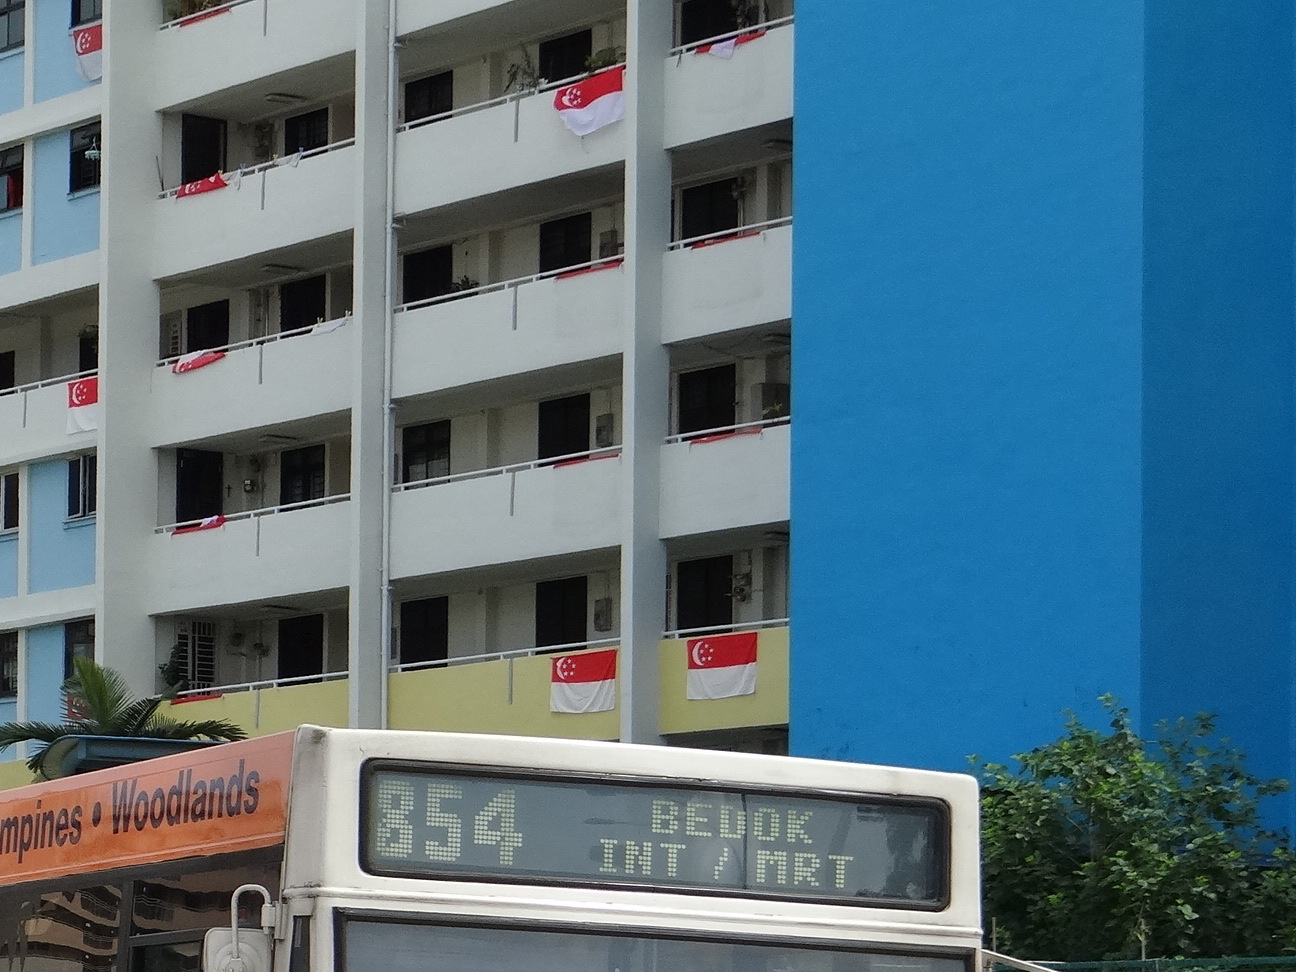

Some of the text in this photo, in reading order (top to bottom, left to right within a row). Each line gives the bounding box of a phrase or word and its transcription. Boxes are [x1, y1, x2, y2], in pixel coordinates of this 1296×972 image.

[111, 758, 261, 835] Woodlands
[374, 779, 523, 866] 854
[651, 799, 814, 845] BEDOK
[599, 838, 687, 878] INT
[756, 849, 854, 889] MRT
